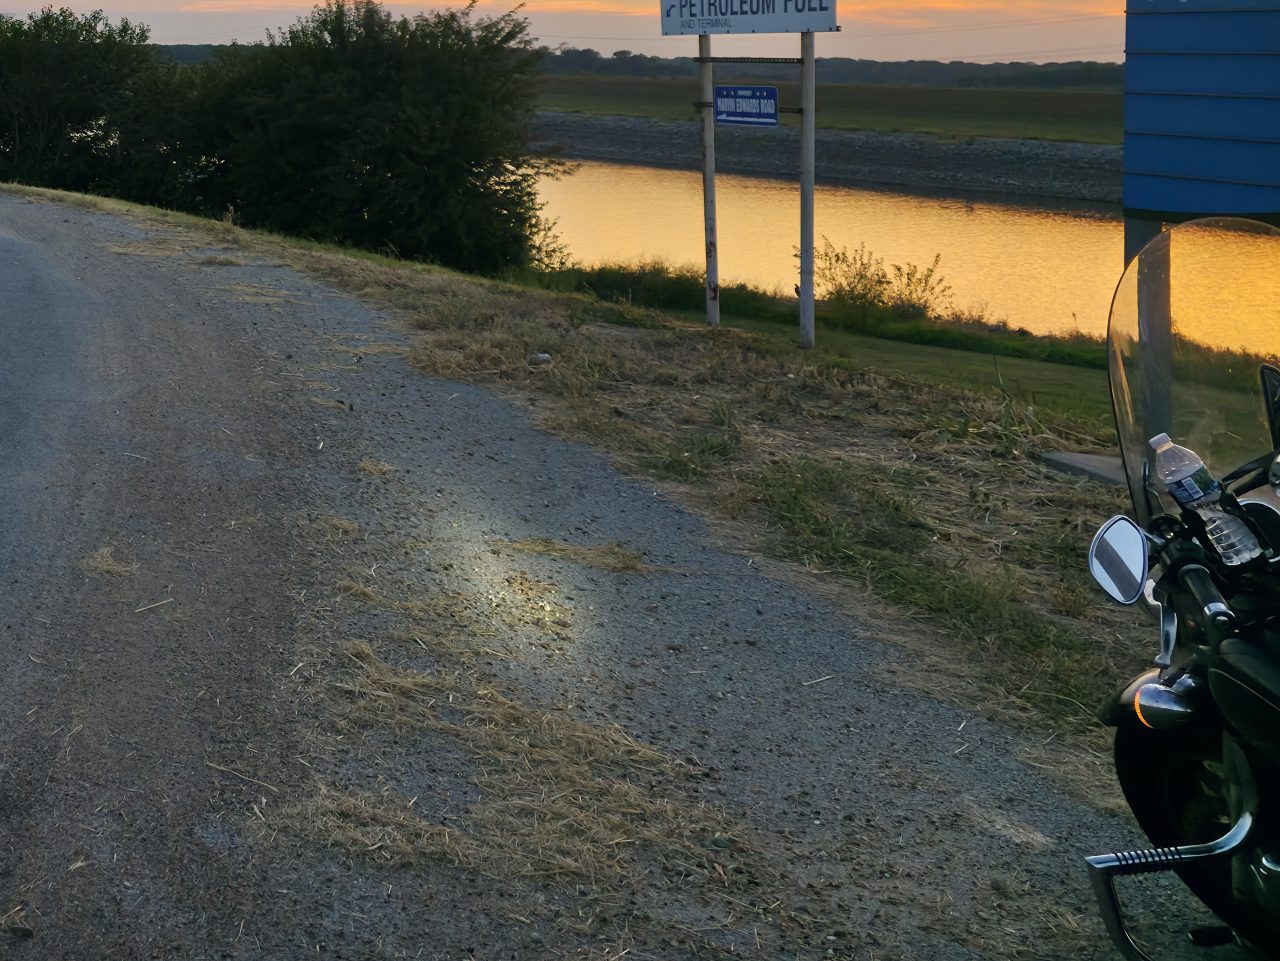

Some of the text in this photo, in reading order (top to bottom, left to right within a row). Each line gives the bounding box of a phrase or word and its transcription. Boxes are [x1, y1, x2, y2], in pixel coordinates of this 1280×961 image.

[680, 18, 733, 29] AND TERMINAL
[736, 98, 760, 114] EDWARDS
[760, 99, 776, 114] ROAD
